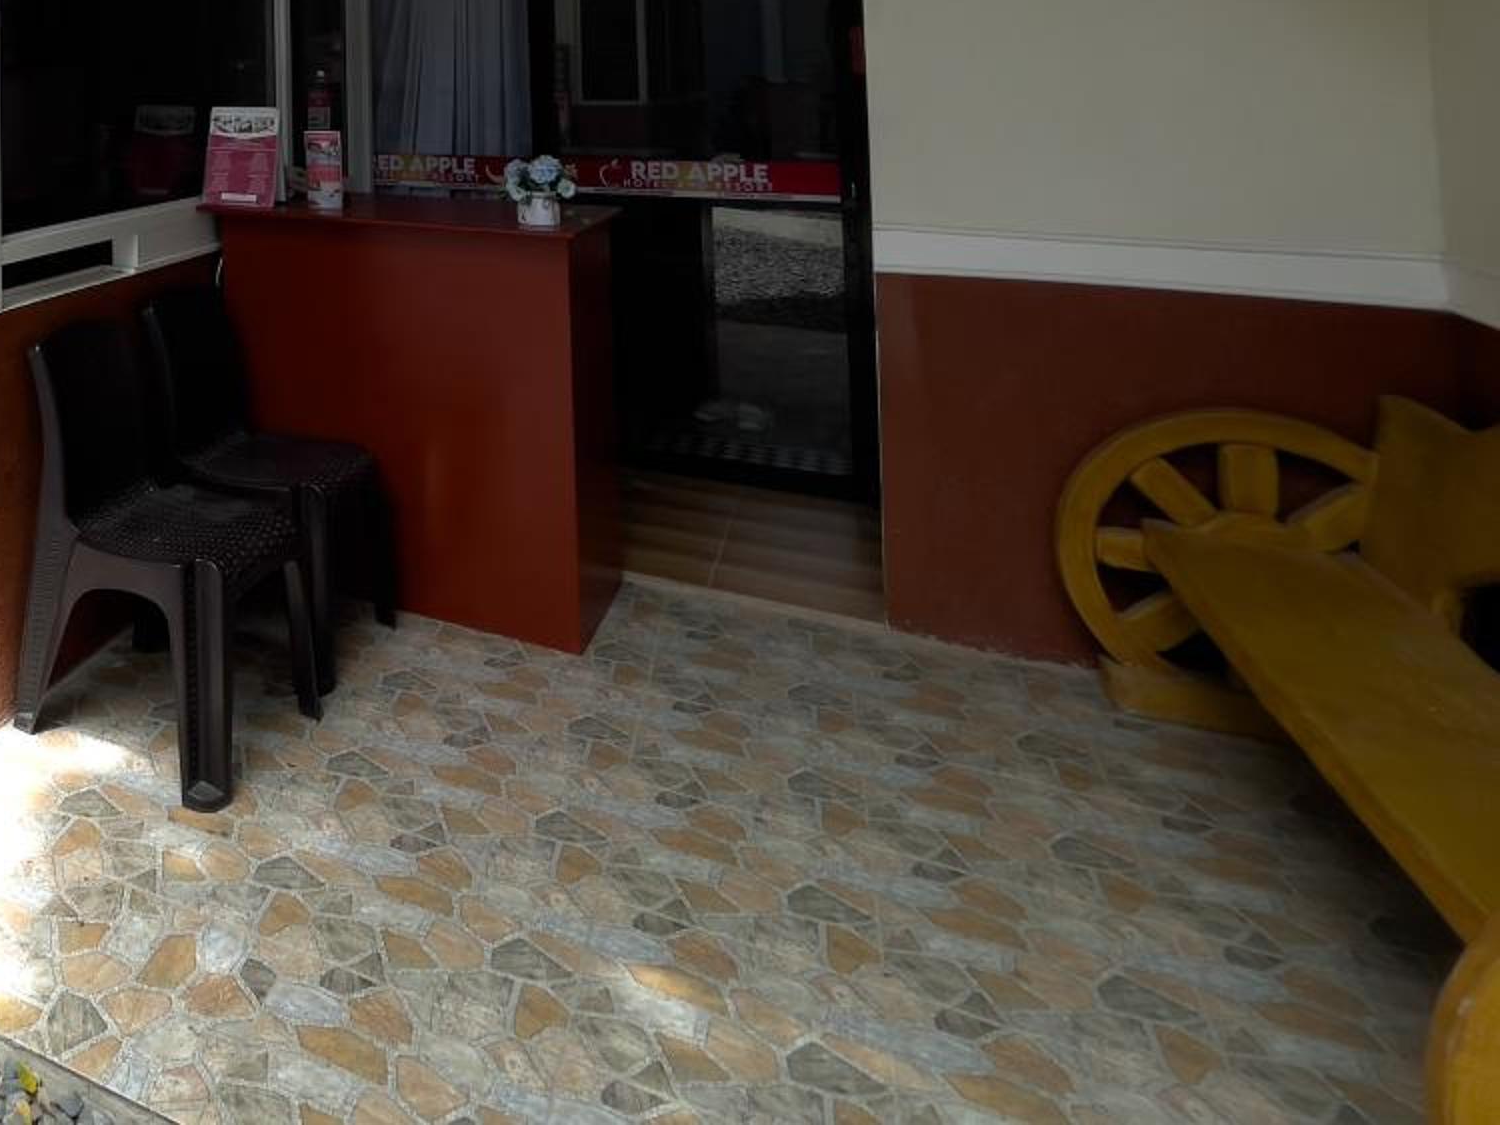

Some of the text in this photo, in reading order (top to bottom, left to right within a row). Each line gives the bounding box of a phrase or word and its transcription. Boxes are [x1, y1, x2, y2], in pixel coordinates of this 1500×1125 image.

[373, 155, 476, 174] ED APPLE
[630, 160, 770, 184] RED APPLE
